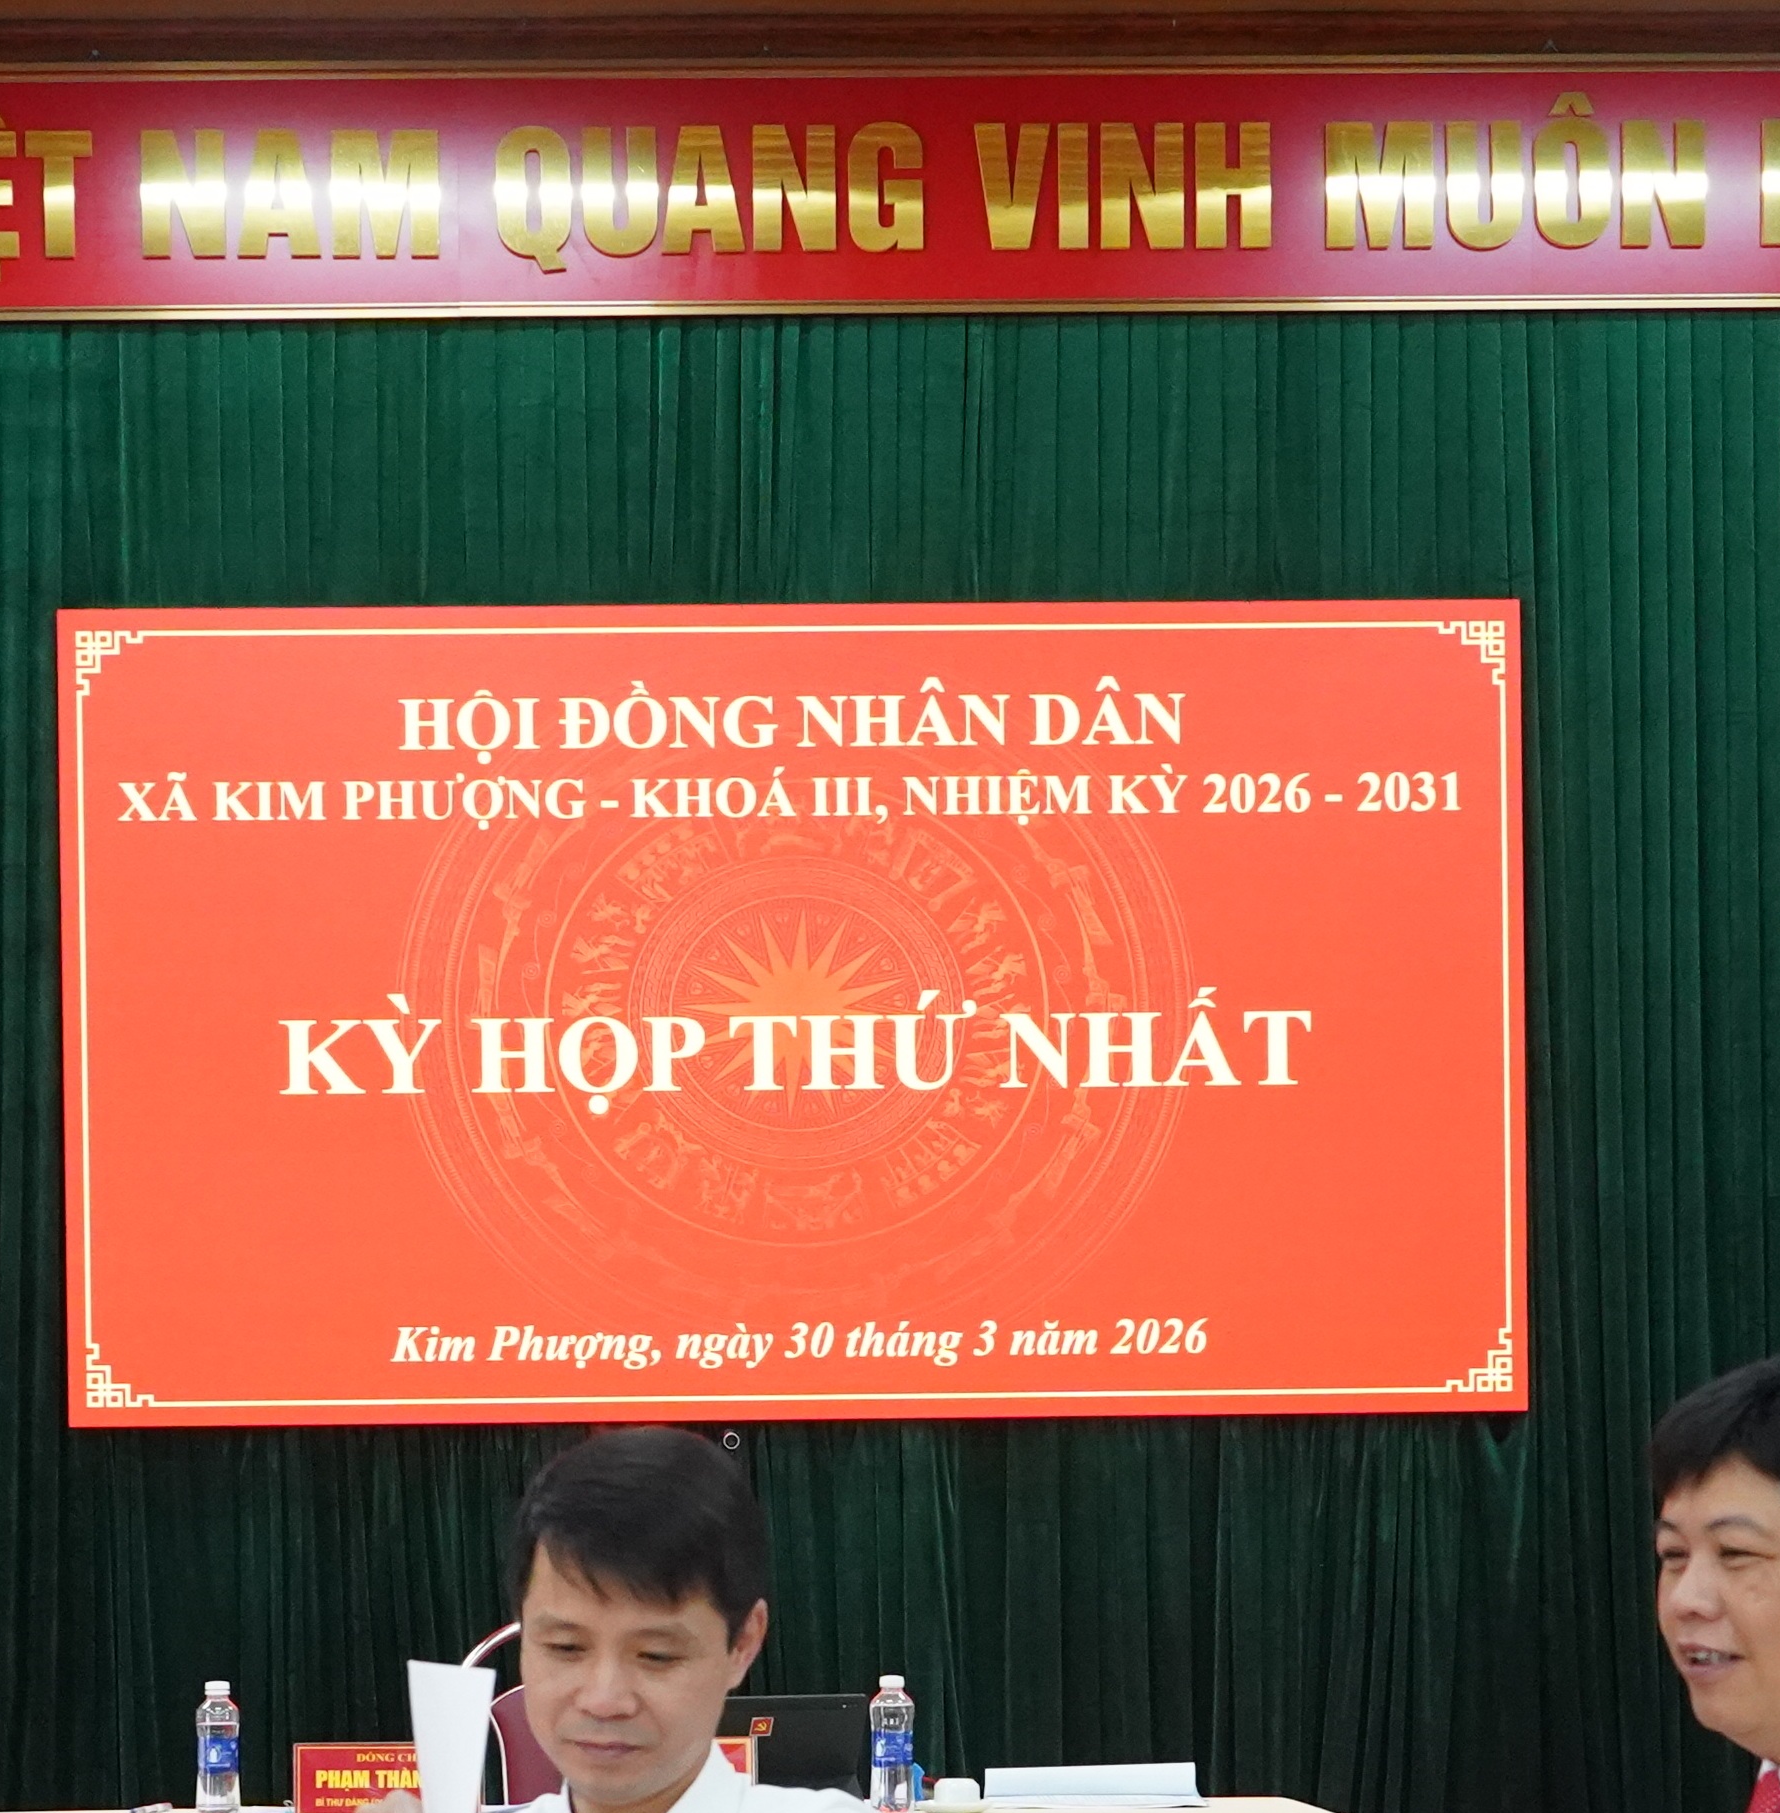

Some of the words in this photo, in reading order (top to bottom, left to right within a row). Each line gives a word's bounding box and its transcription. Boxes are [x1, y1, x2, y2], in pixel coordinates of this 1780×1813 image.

[140, 129, 440, 260] NAM
[493, 121, 924, 273] QUANG
[973, 121, 1272, 251] VINH
[1324, 91, 1707, 251] MUÔN
[398, 690, 540, 764] HỘI
[559, 681, 778, 750] ĐỒNG
[796, 677, 1009, 748] NHÂN
[1029, 676, 1186, 746] DÂN
[118, 772, 198, 821] XÃ
[213, 781, 327, 821] KIM
[343, 773, 587, 830] PHƯỢNG
[629, 767, 797, 818] KHOÁ
[811, 777, 889, 824] III,
[903, 769, 1091, 825] NHIỆM
[1108, 764, 1188, 814] KỲ
[1202, 773, 1312, 814] 2026
[1357, 771, 1461, 813] 2031
[278, 993, 442, 1095] KỲ
[470, 1015, 706, 1114] HỌP
[728, 989, 978, 1091] THỨ
[999, 986, 1312, 1089] NHẤT
[390, 1325, 476, 1363] Kim
[486, 1324, 662, 1370] Phượng,
[675, 1322, 774, 1369] ngày
[784, 1321, 835, 1359] 30
[845, 1320, 964, 1367] tháng
[972, 1319, 998, 1357] 3
[1009, 1320, 1098, 1356] năm
[1110, 1317, 1207, 1355] 2026
[315, 1769, 371, 1792] PHẠM
